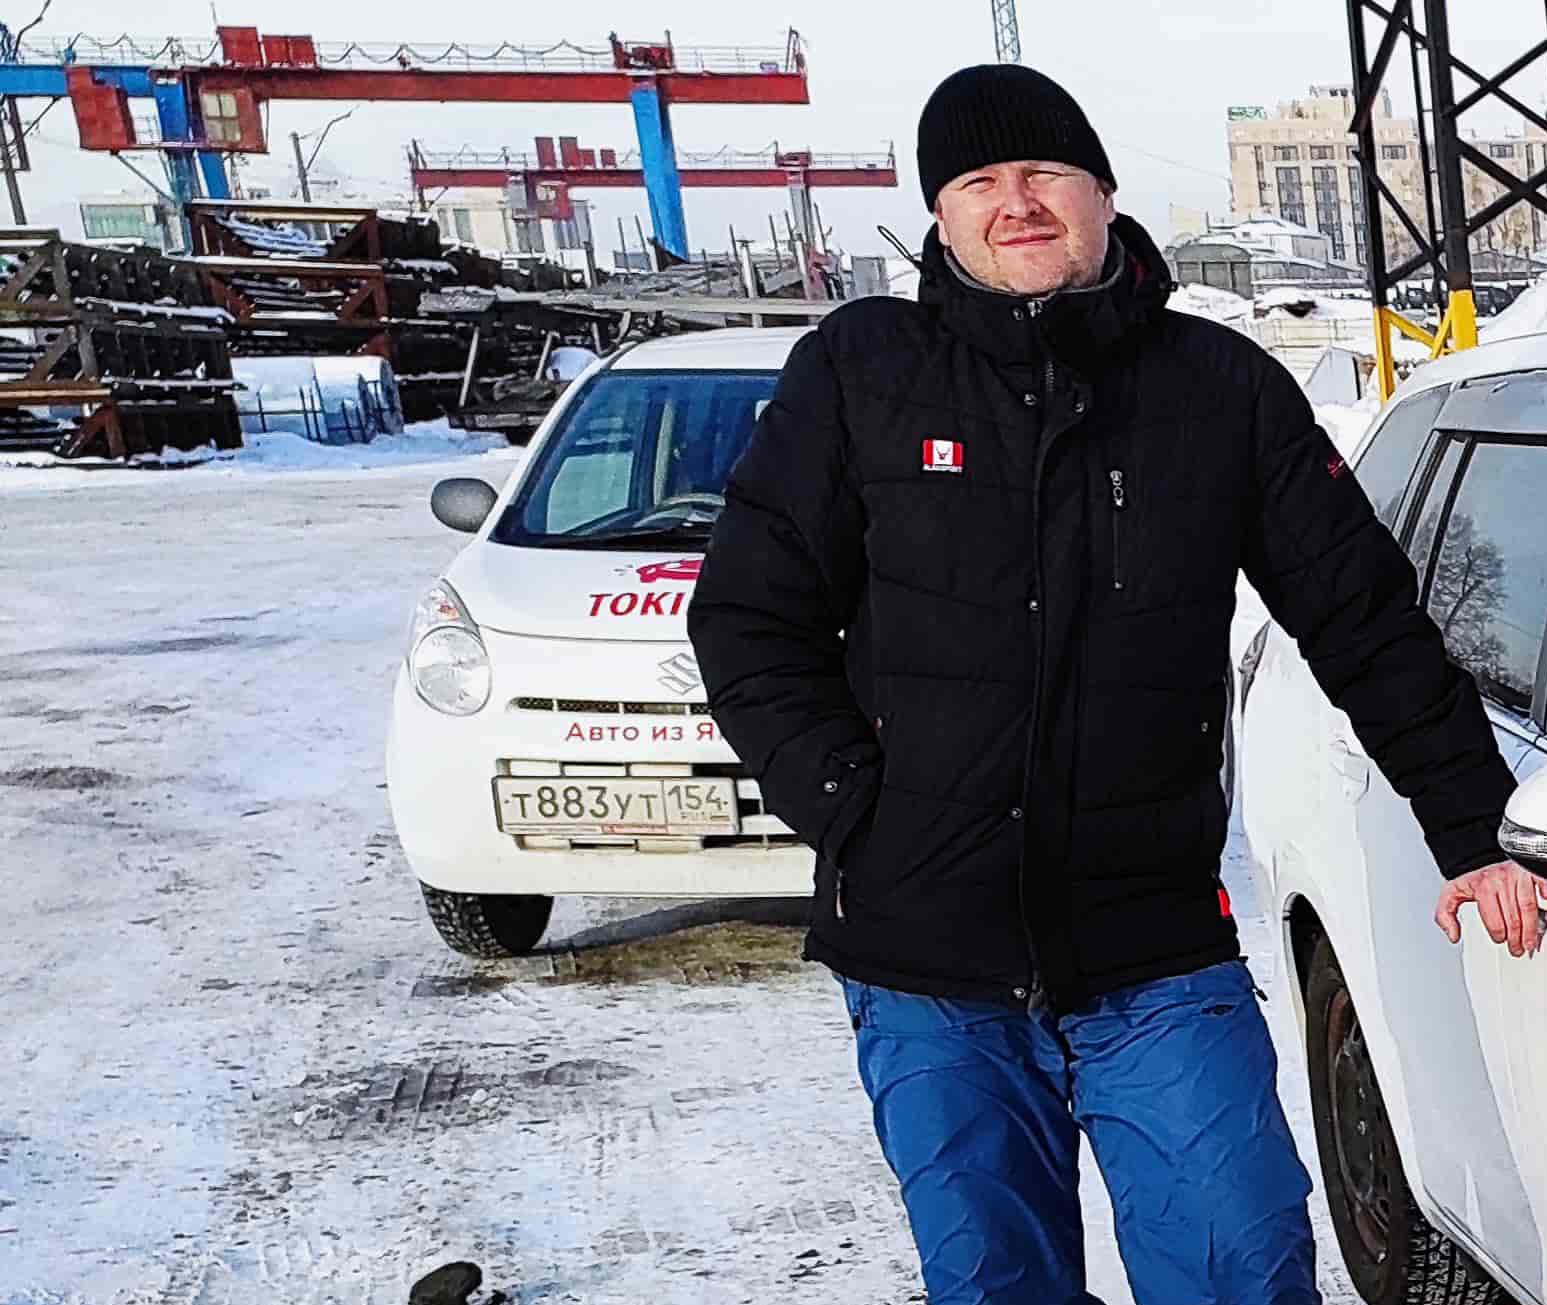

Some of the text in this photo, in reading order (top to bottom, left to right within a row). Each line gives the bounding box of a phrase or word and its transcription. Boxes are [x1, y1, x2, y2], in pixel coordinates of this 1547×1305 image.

[565, 722, 722, 742] Авто из Я
[667, 785, 722, 810] 154
